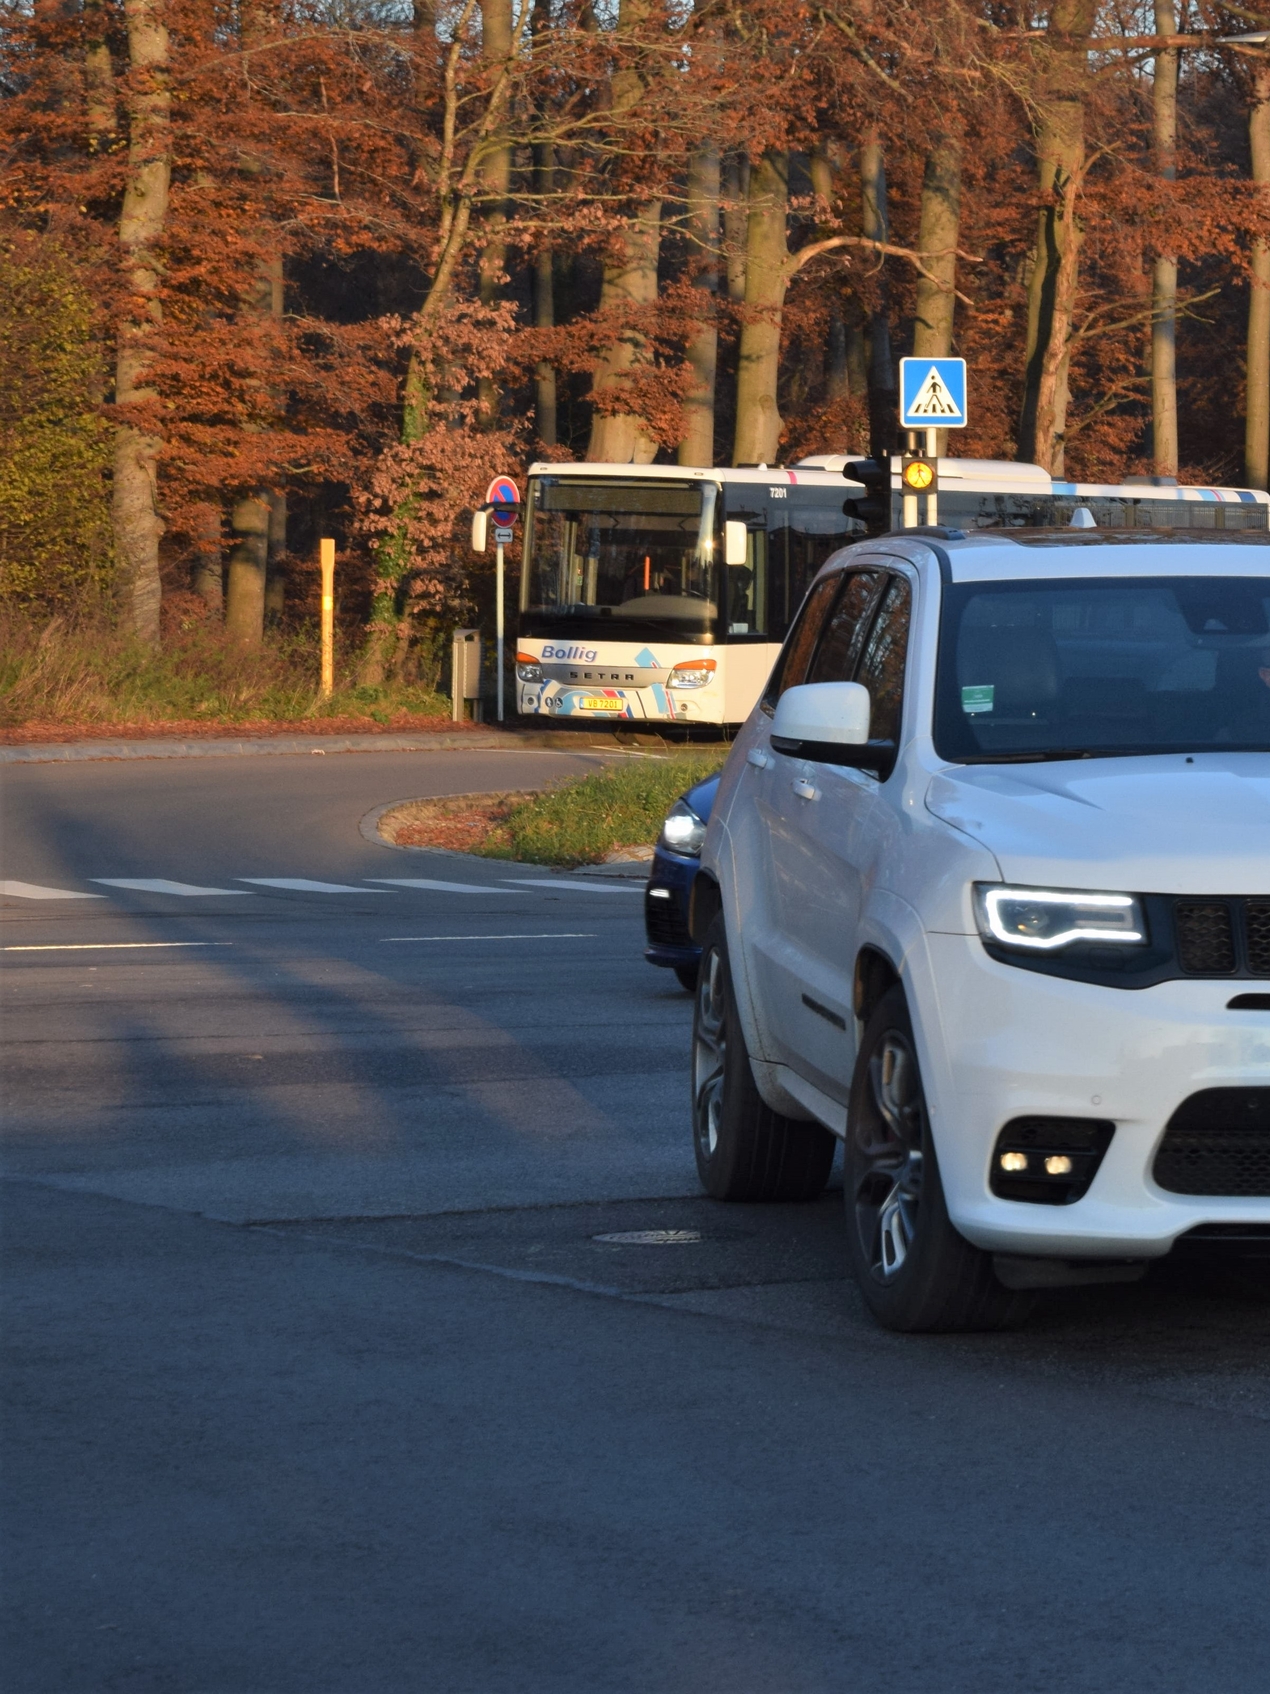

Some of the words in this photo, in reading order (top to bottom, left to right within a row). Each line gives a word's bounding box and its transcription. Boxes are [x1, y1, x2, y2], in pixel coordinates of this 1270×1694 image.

[769, 487, 787, 498] 7201
[541, 645, 598, 663] Bollig
[569, 671, 635, 681] SETRA
[600, 699, 618, 709] 7201
